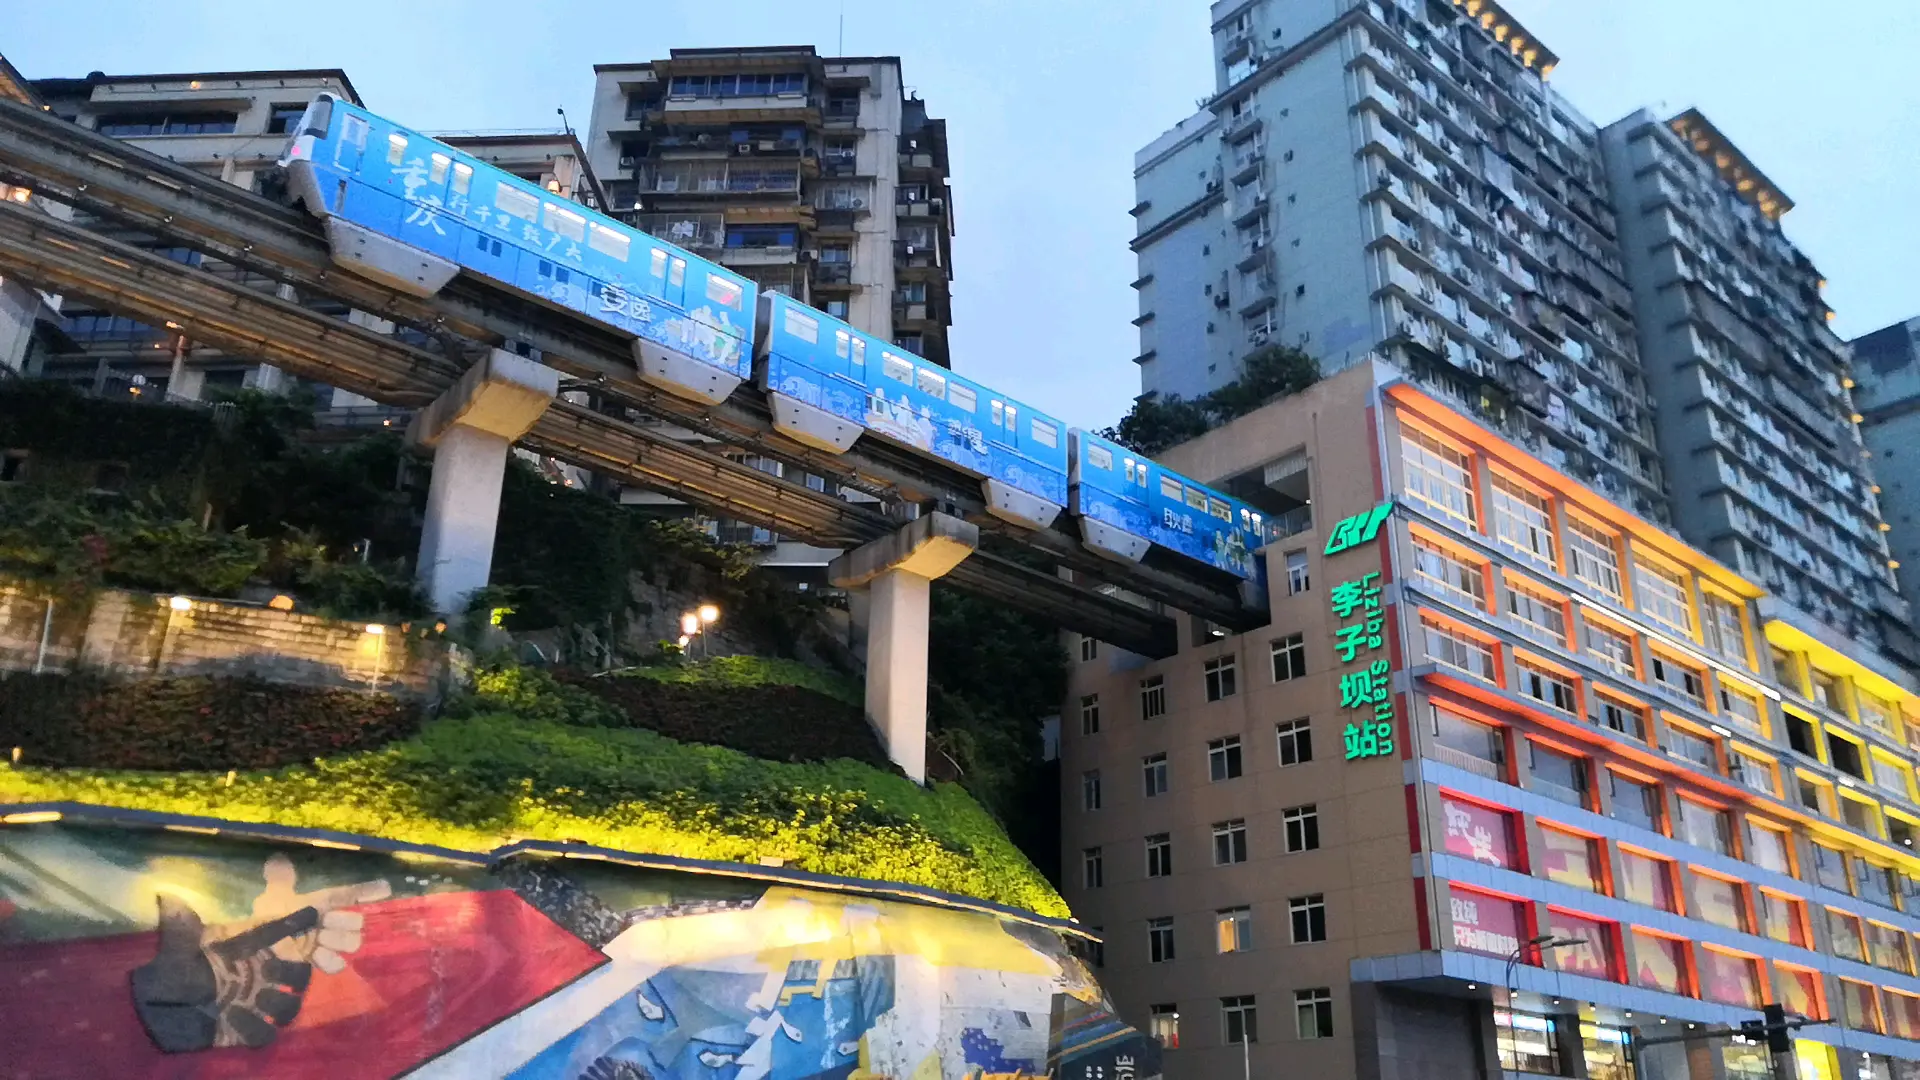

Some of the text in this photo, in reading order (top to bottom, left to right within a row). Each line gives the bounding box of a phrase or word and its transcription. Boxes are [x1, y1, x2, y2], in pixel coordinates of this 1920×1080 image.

[391, 157, 446, 236] 重庆
[600, 283, 652, 323] 安逸
[1331, 581, 1378, 760] 李子坝站
[1362, 571, 1394, 755] Liziba Station
